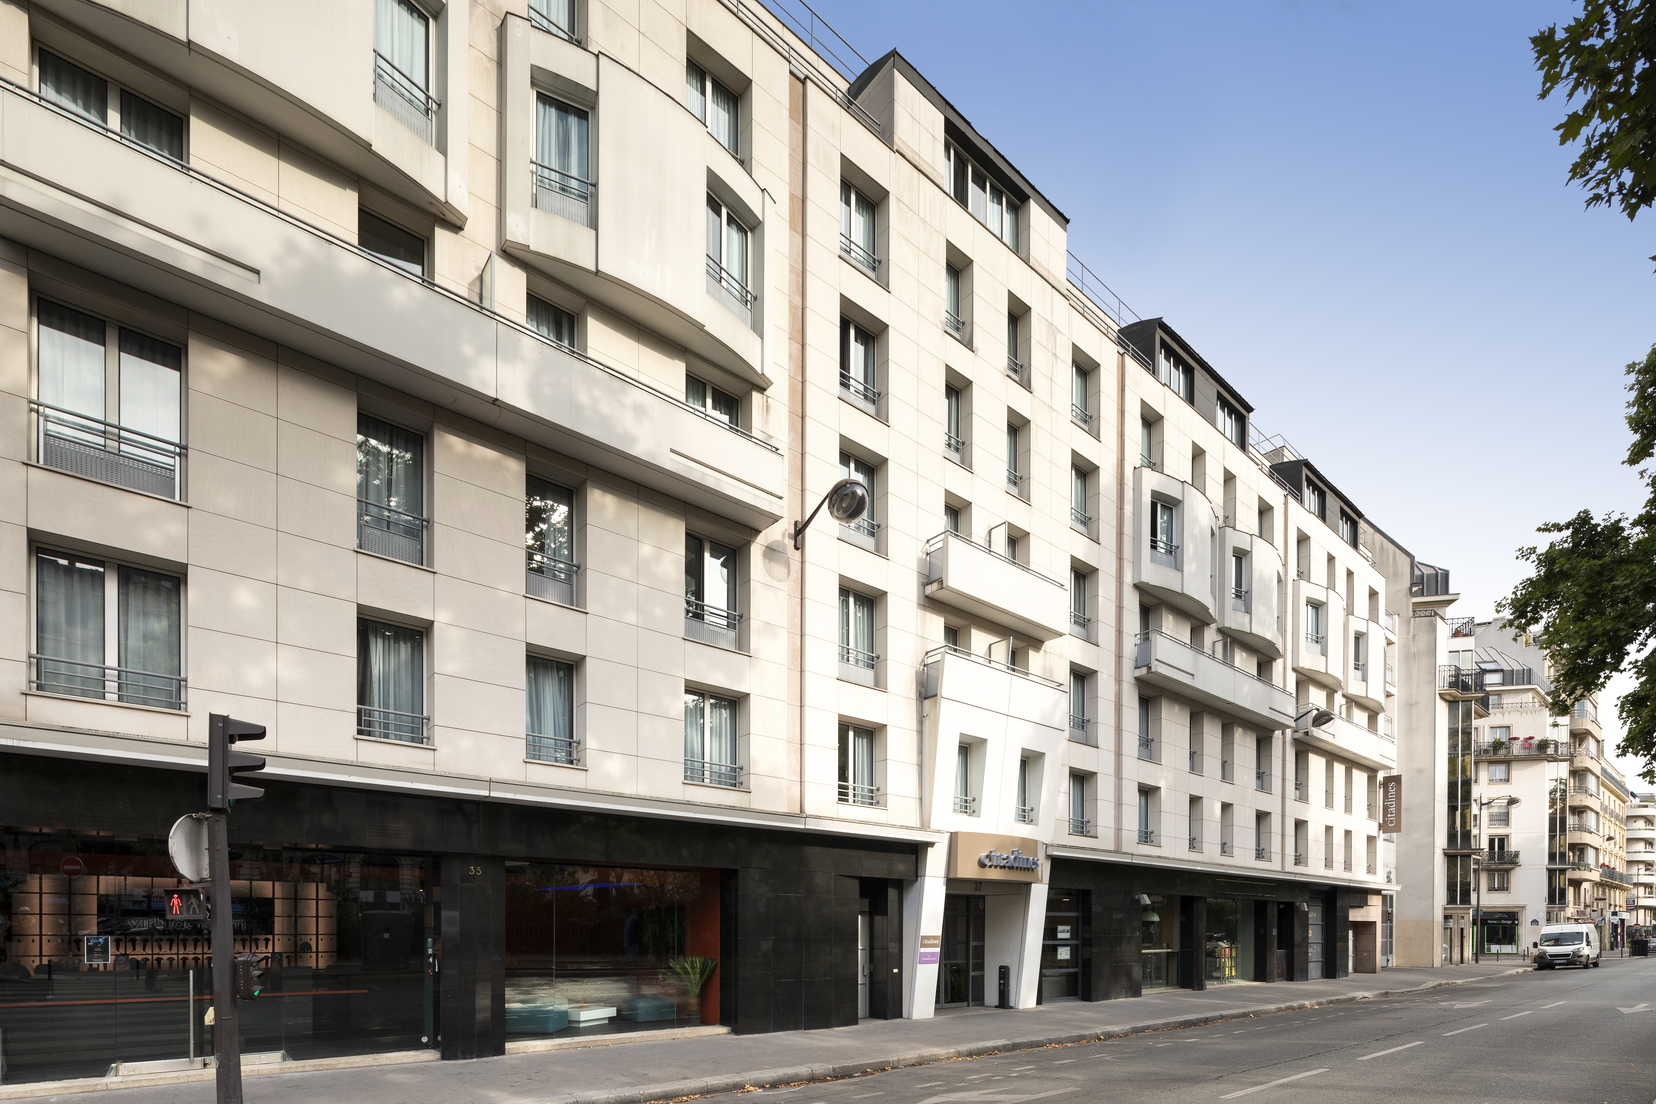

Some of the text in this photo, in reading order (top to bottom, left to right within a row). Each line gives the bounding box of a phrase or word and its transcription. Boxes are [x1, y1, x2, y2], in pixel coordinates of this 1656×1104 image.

[1384, 781, 1396, 827] citadines
[980, 848, 1040, 869] citadines
[469, 866, 482, 876] 35
[974, 881, 982, 892] 37
